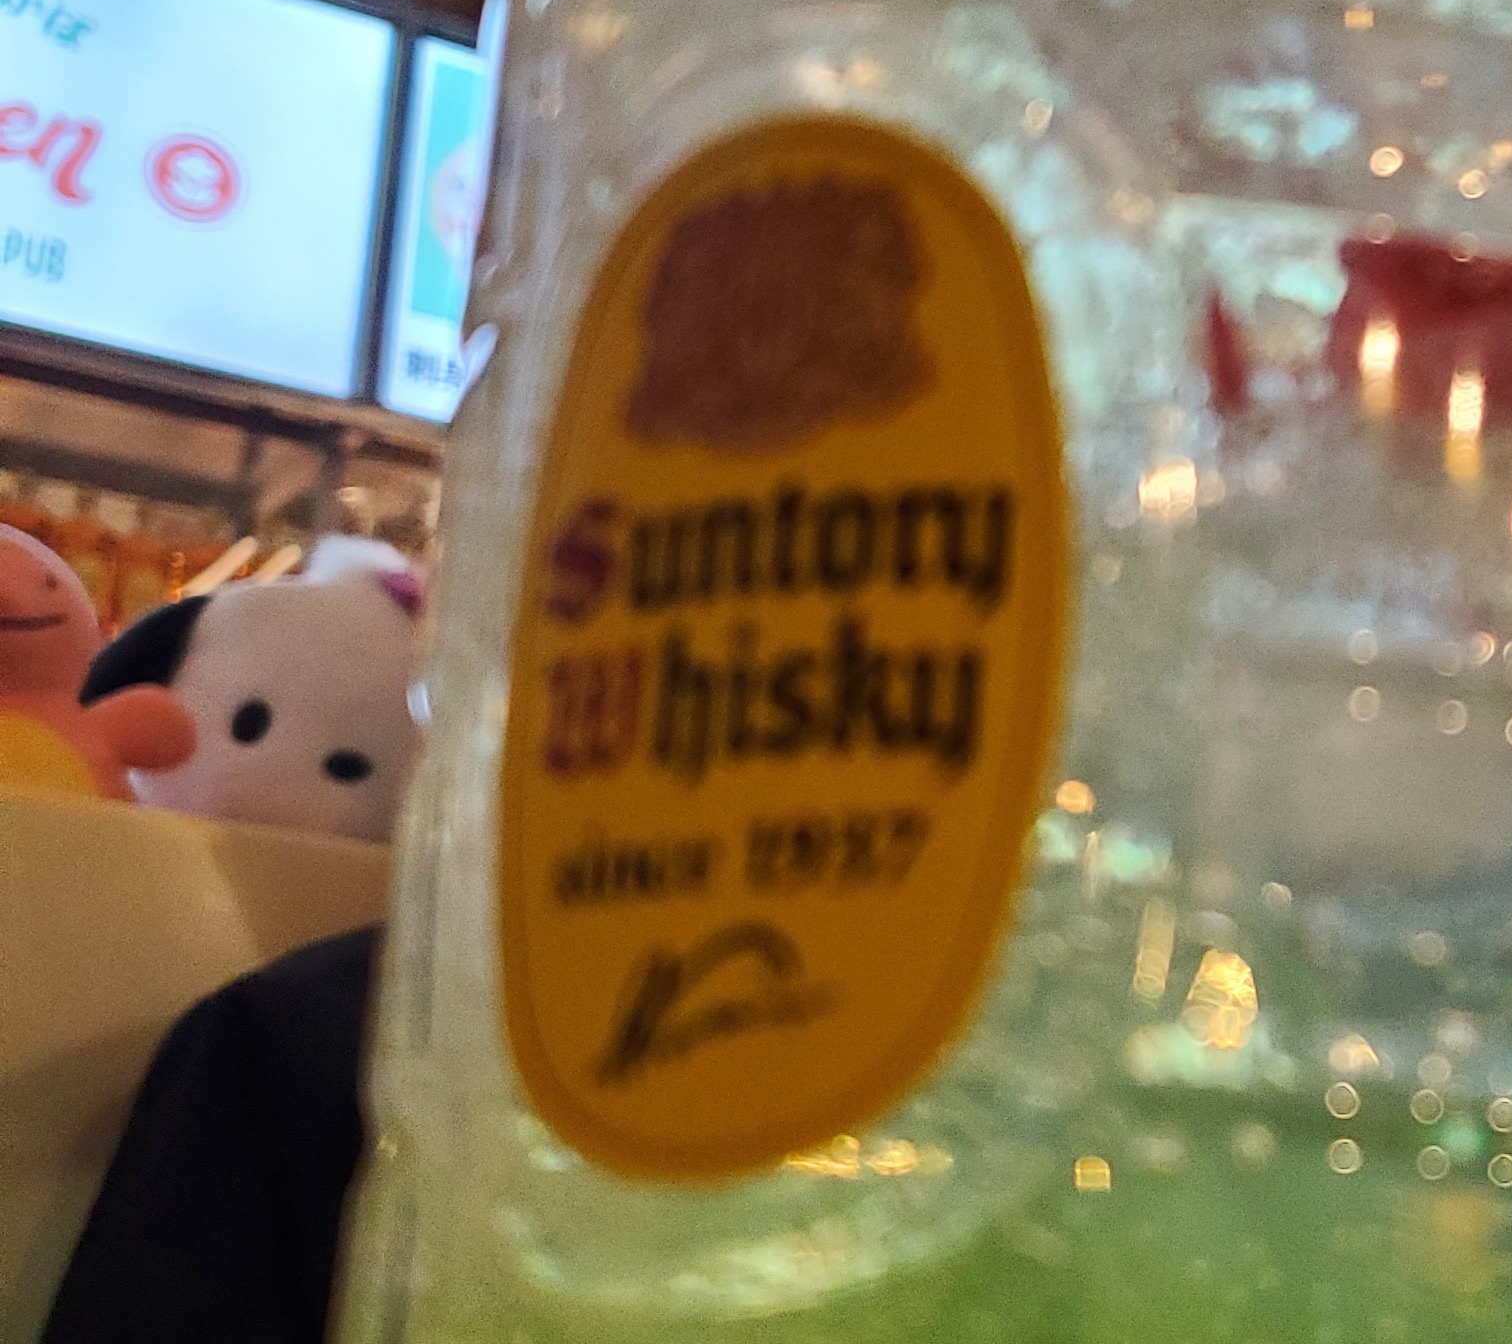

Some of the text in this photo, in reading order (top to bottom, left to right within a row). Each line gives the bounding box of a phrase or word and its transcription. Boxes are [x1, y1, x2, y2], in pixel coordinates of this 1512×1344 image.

[2, 227, 67, 282] PUB
[546, 478, 1015, 628] Suntory
[543, 613, 988, 784] Whisky
